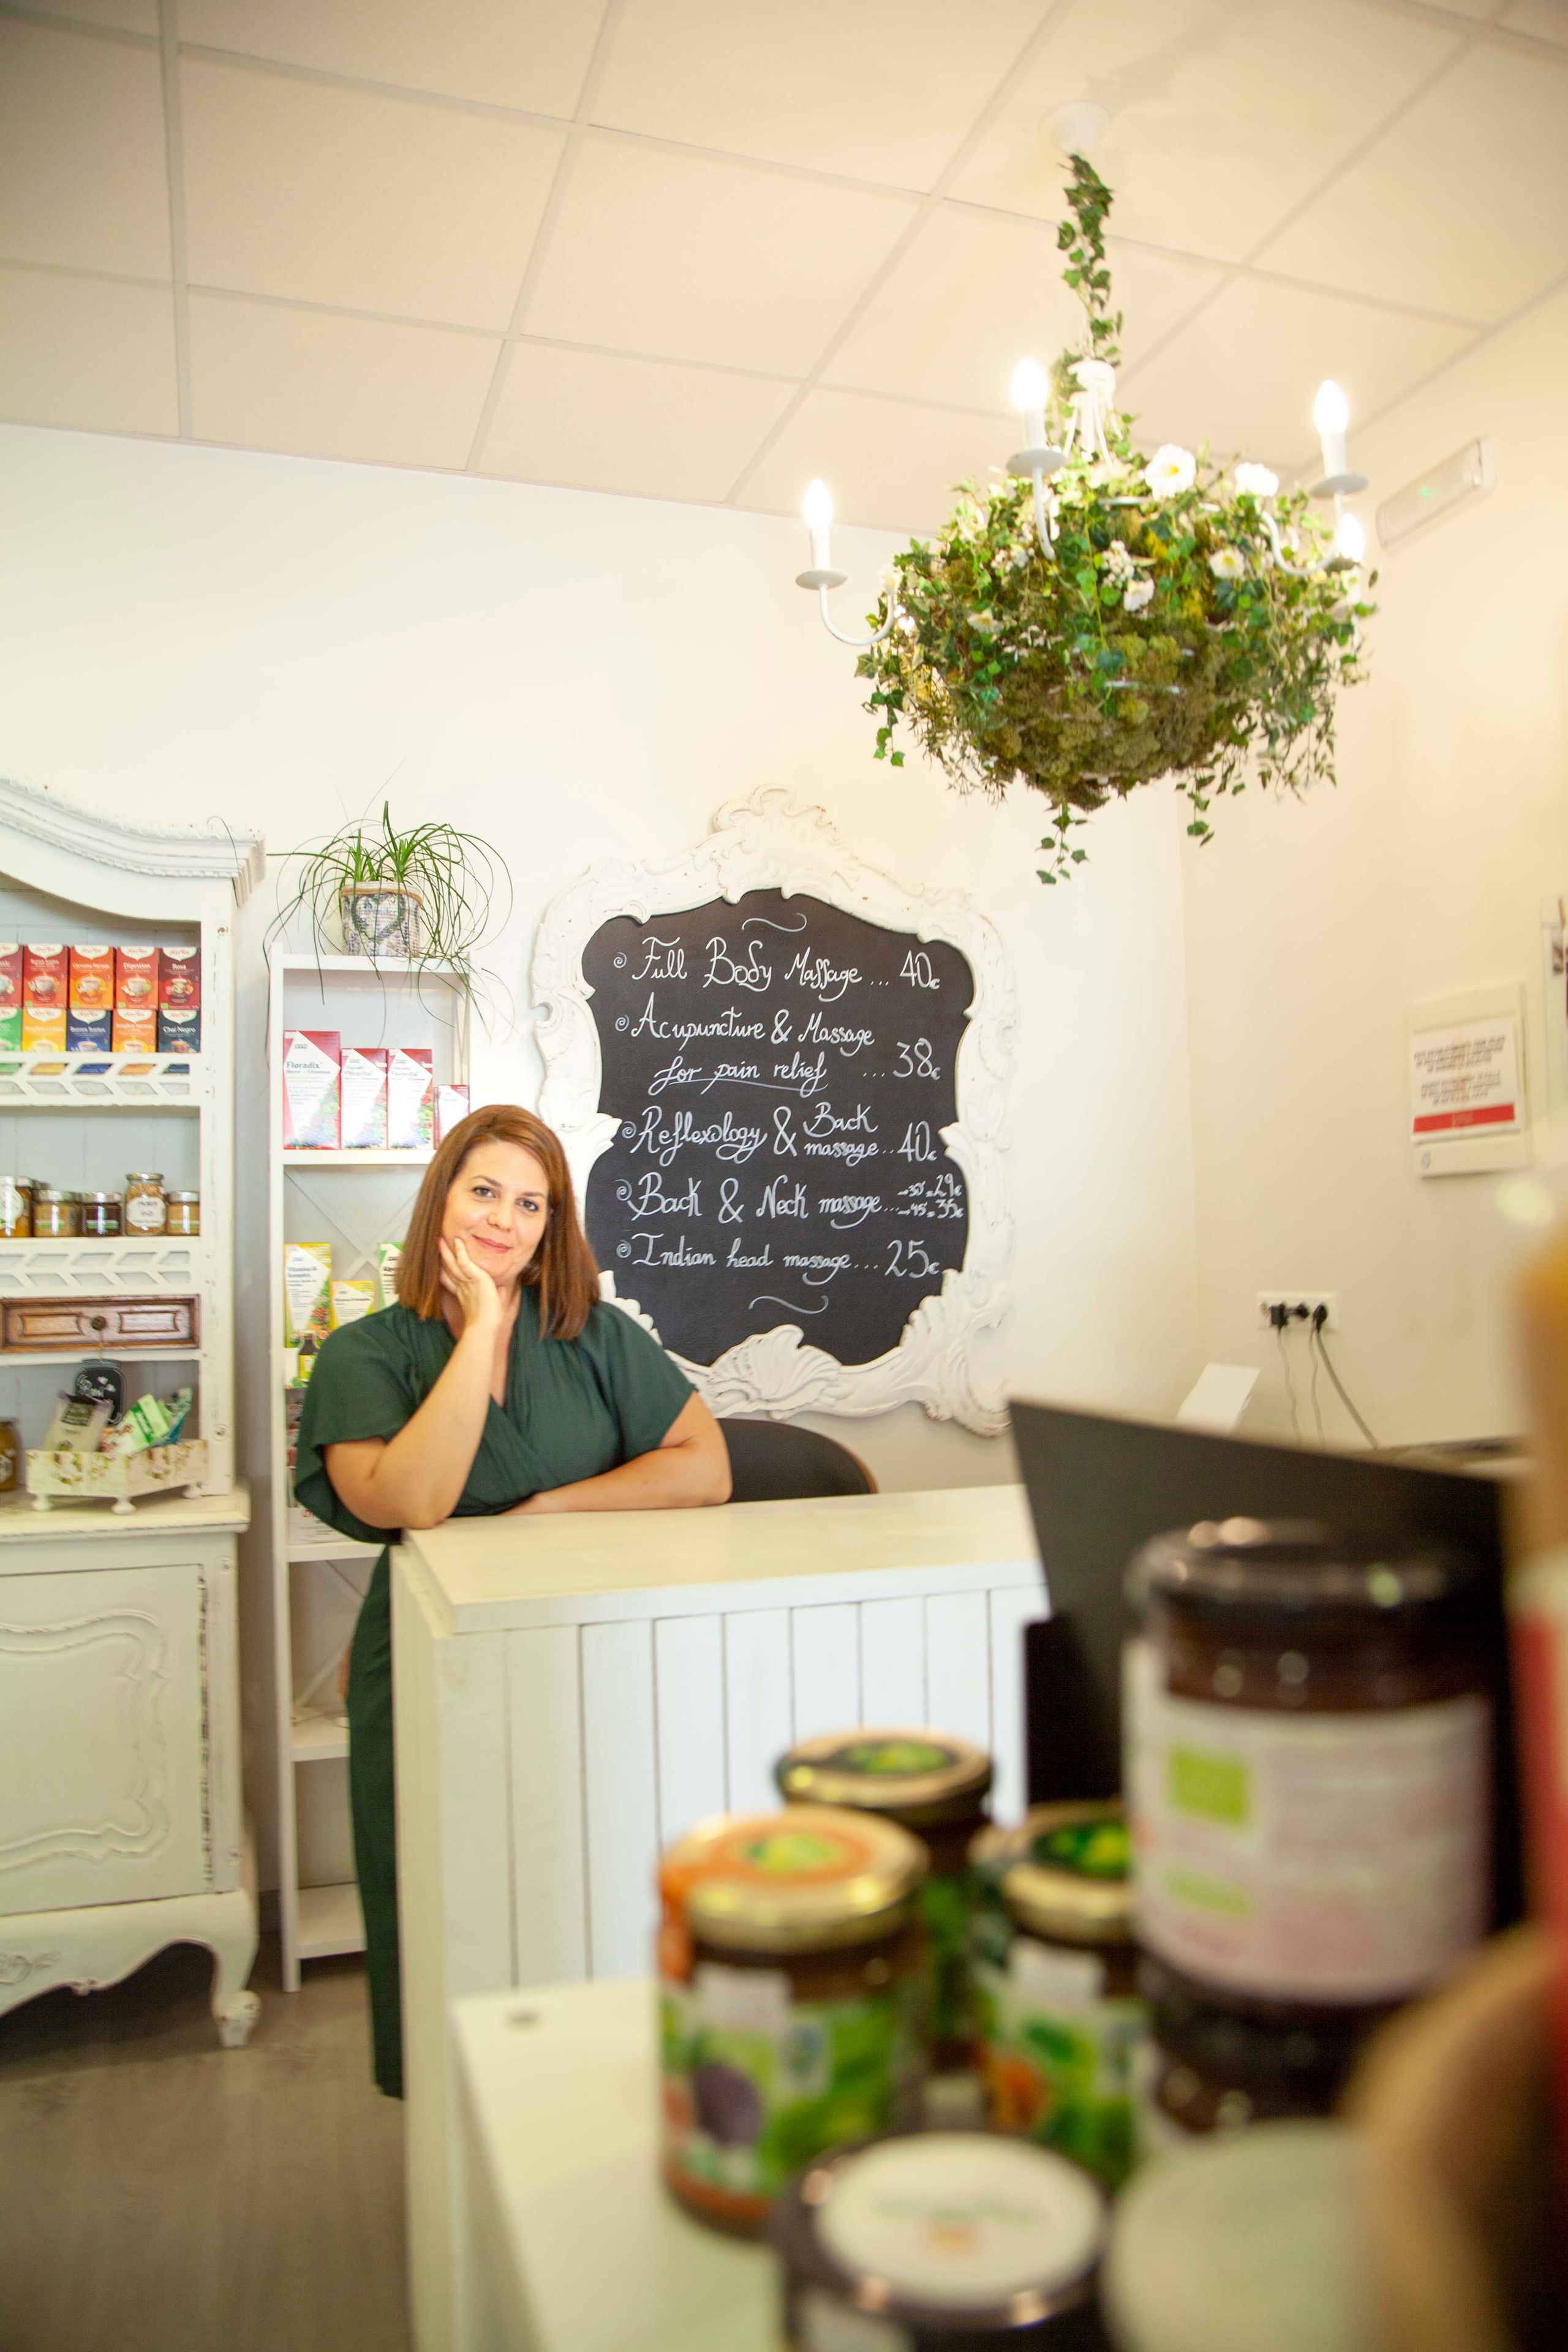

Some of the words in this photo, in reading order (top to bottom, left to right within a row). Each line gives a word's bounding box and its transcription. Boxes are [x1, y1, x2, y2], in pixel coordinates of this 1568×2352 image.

[631, 937, 687, 980] Full
[703, 937, 772, 992] Body
[631, 992, 765, 1051] Acupuncture
[771, 1009, 793, 1044] &
[797, 1011, 875, 1057] Massage
[648, 1055, 703, 1096] for
[700, 1061, 760, 1095] pain
[774, 1051, 827, 1098] relief
[630, 1106, 767, 1167] Reflexology
[773, 1106, 797, 1157] &
[803, 1102, 878, 1137] Back
[627, 1172, 703, 1221] Back
[718, 1178, 744, 1224] &
[756, 1174, 809, 1219] Neck
[631, 1233, 717, 1267] Indian
[726, 1237, 774, 1267] head
